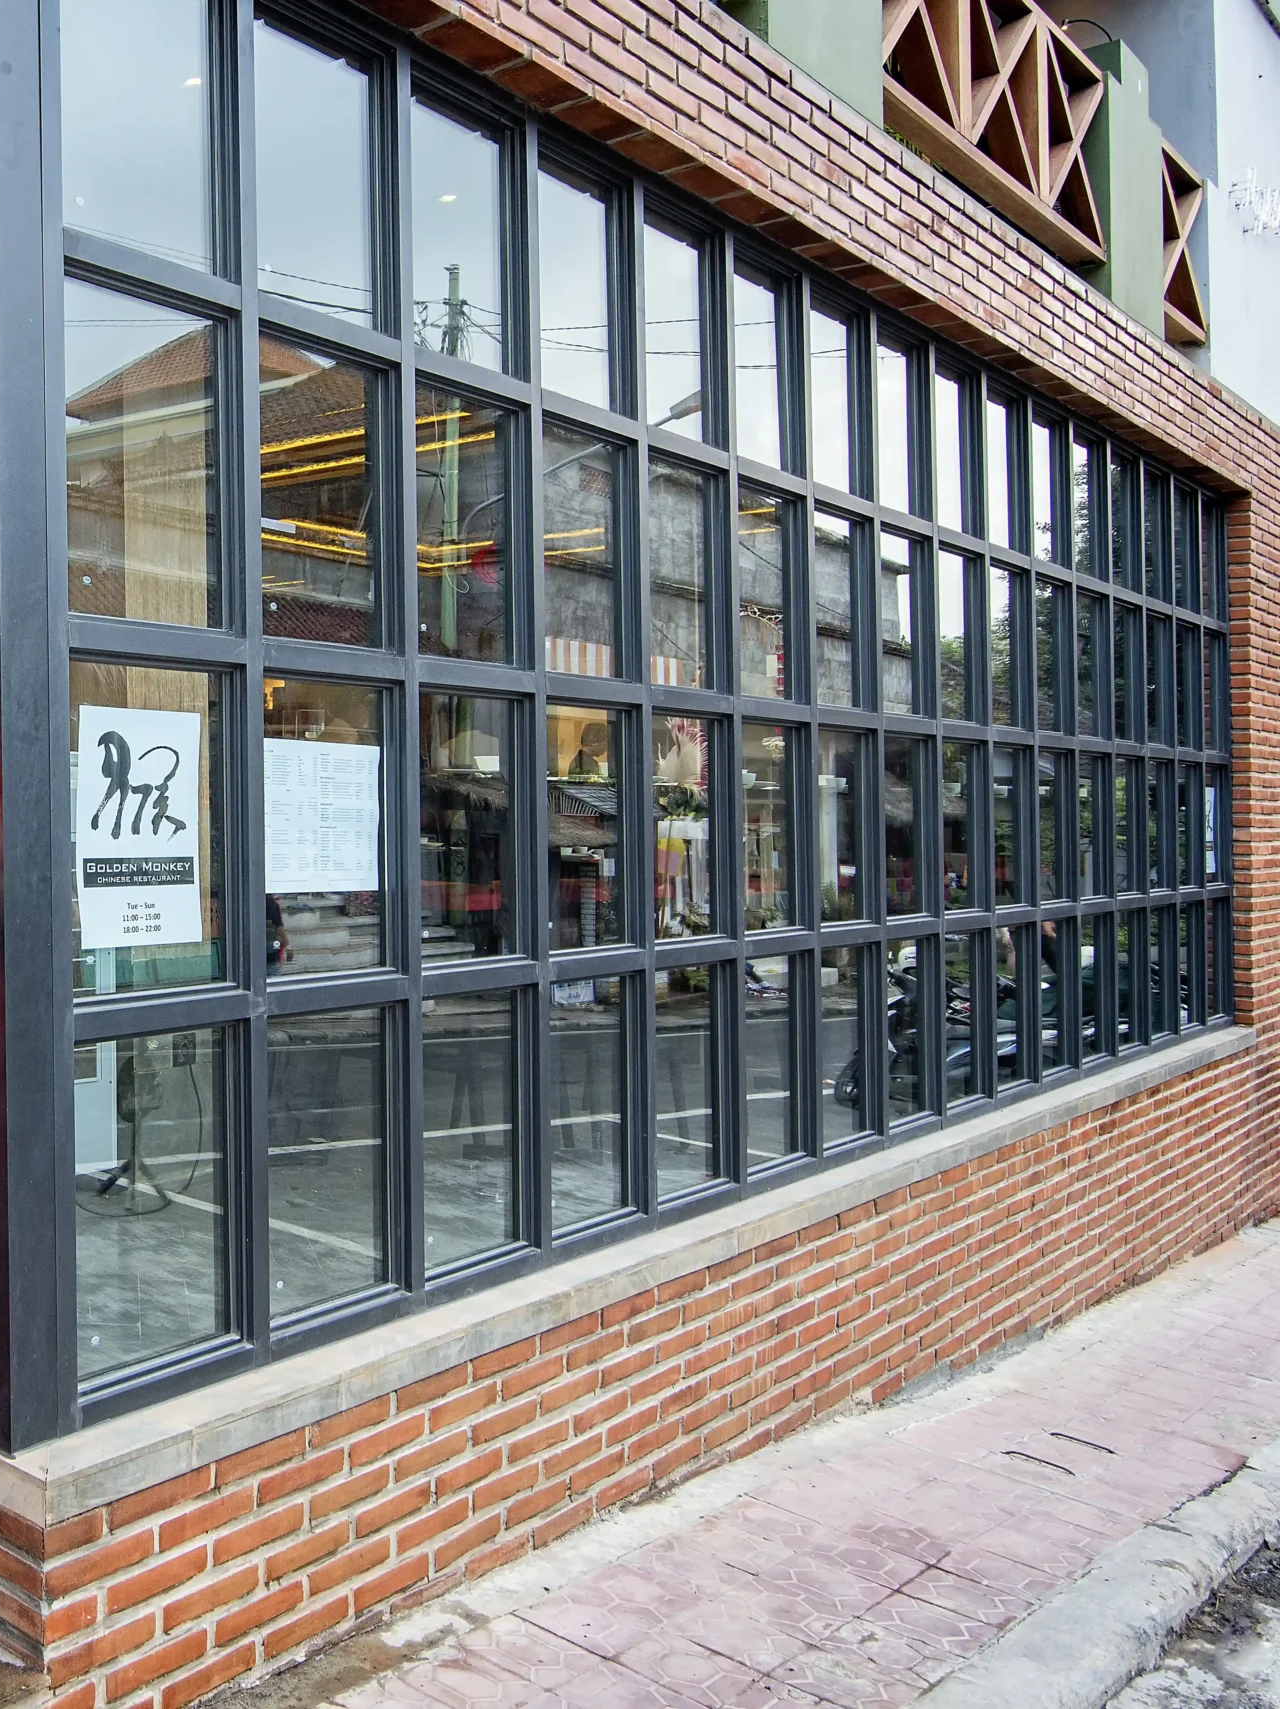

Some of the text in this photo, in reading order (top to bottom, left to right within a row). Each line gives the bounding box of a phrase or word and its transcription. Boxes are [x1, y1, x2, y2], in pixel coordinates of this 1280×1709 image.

[86, 861, 191, 873] GOLDEN MONKEY
[97, 875, 181, 884] CHINESE RESTAURANT
[127, 902, 138, 910] Tue
[122, 914, 138, 922] 11:00
[145, 913, 161, 921] 15:00
[123, 926, 139, 934] 18:00
[145, 924, 161, 932] 22:00
